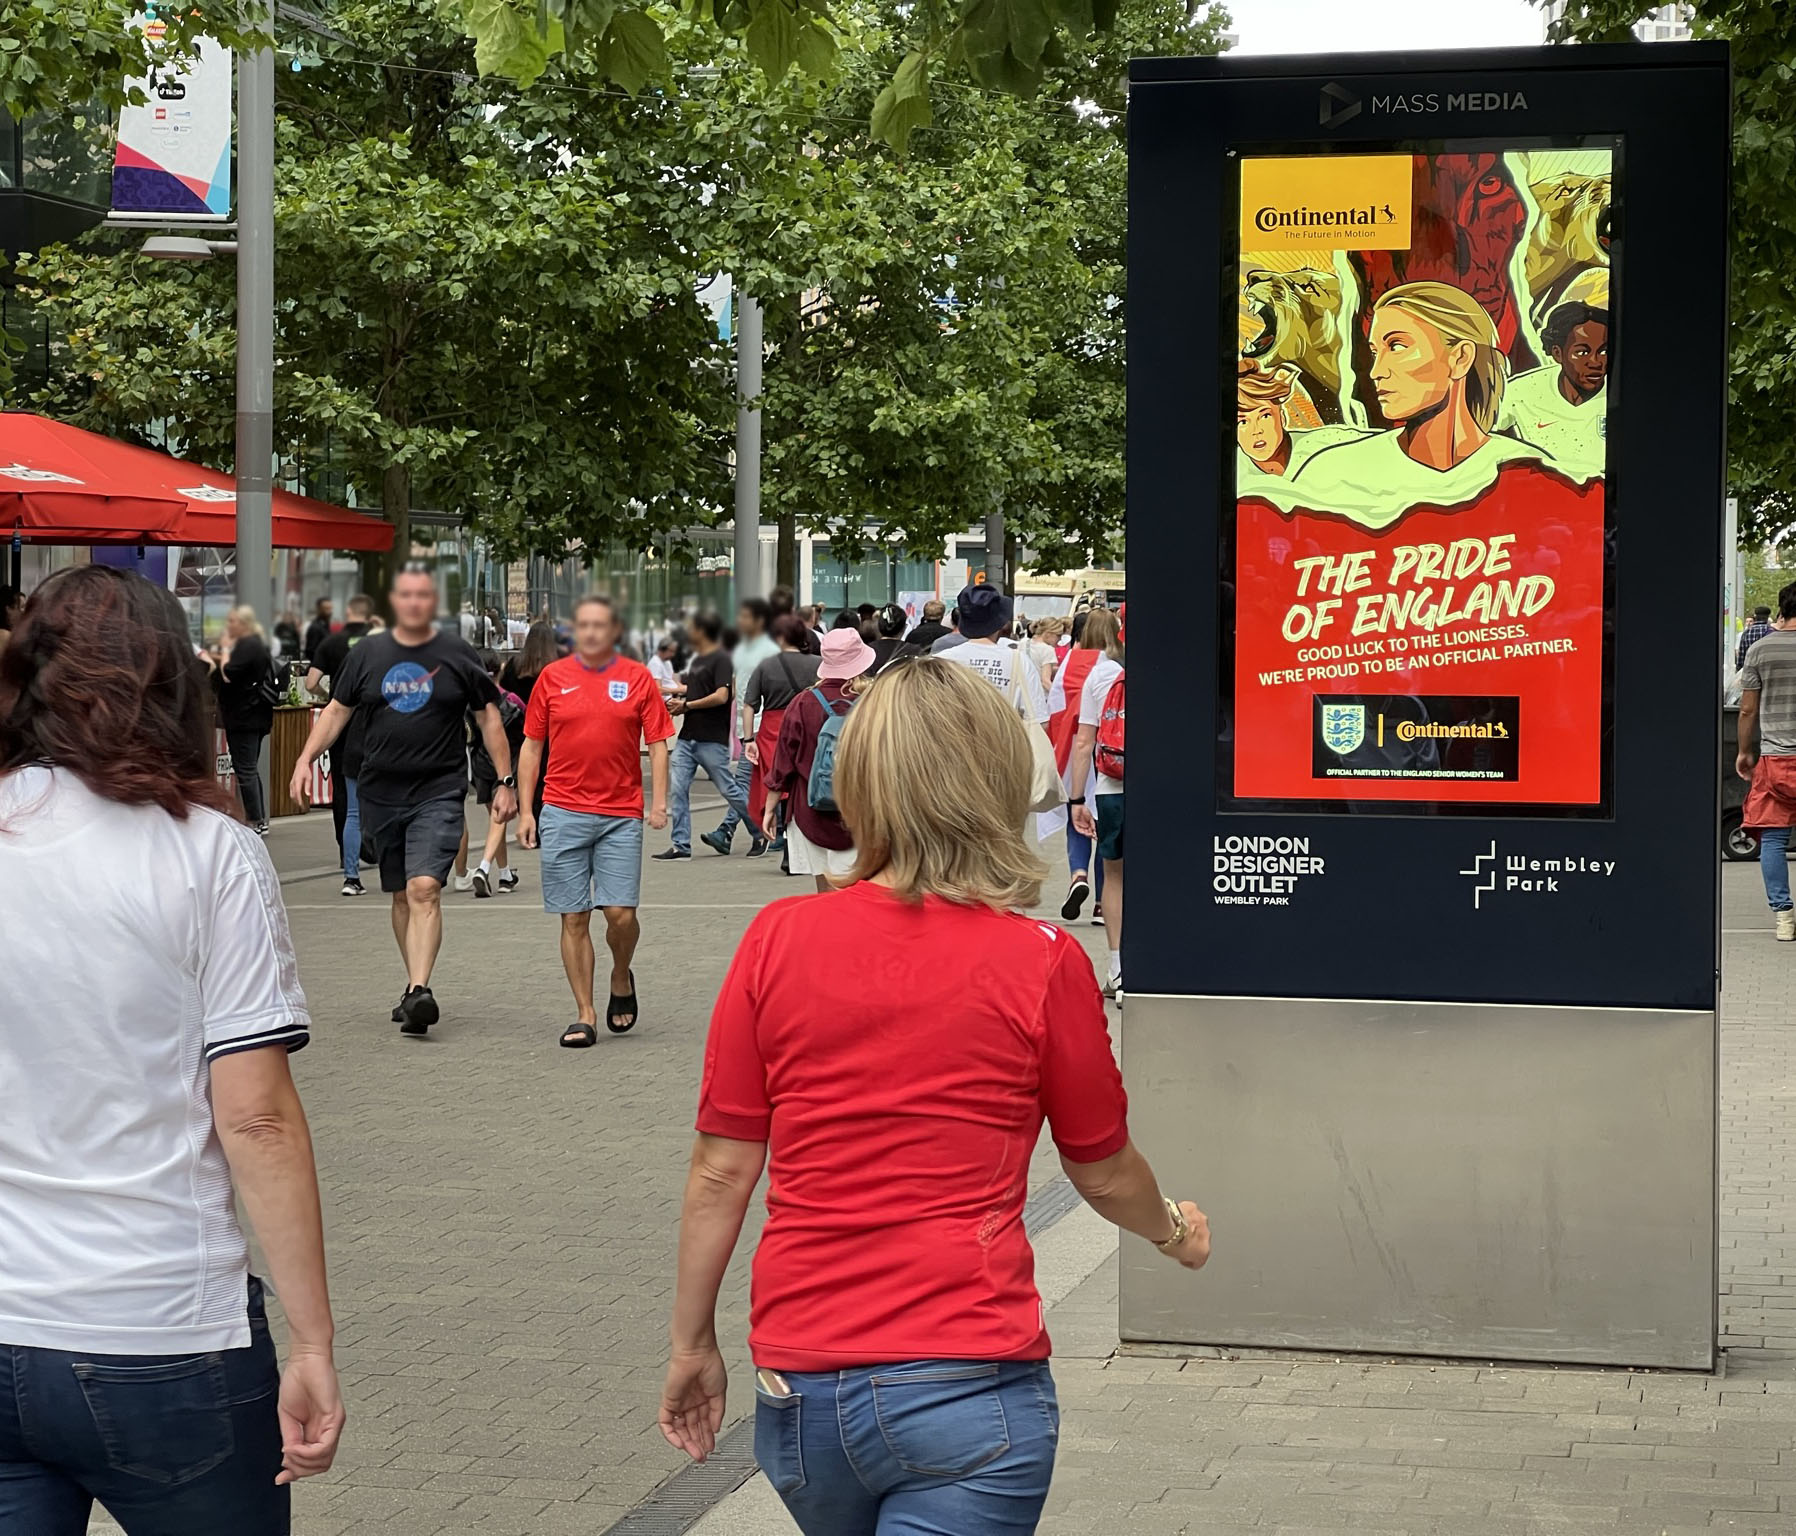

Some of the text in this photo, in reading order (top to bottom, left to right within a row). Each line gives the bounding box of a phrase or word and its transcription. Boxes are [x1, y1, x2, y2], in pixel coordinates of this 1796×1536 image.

[1371, 91, 1529, 114] MASS MEDIA
[1255, 205, 1376, 232] Continental
[1285, 230, 1376, 239] The Future in Motion
[1294, 533, 1516, 597] THE PRIDE
[1282, 575, 1556, 643] OF ENGLAND
[1297, 624, 1529, 663] GOOD LUCK TO THE LIONESSES.
[1258, 638, 1578, 687] WE'RE PROUD TO BE AN OFFICIAL PARTNER.
[988, 668, 1003, 676] BIG
[385, 681, 430, 694] NASA
[1396, 720, 1493, 742] Continental
[1326, 768, 1353, 777] OFFICIAL
[1353, 769, 1381, 777] PARTNER
[1381, 769, 1390, 777] TO
[1390, 769, 1402, 777] THE
[1432, 770, 1455, 778] SENIOR
[1455, 770, 1486, 778] WOMEN'S
[1485, 771, 1504, 779] TEAM
[1214, 836, 1309, 854] LONDON
[1214, 856, 1325, 874] DESIGNER
[1506, 855, 1616, 876] Wembley
[1213, 875, 1298, 893] OUTLET
[1506, 877, 1559, 892] Park
[1214, 896, 1289, 905] WEMBLEY PARK
